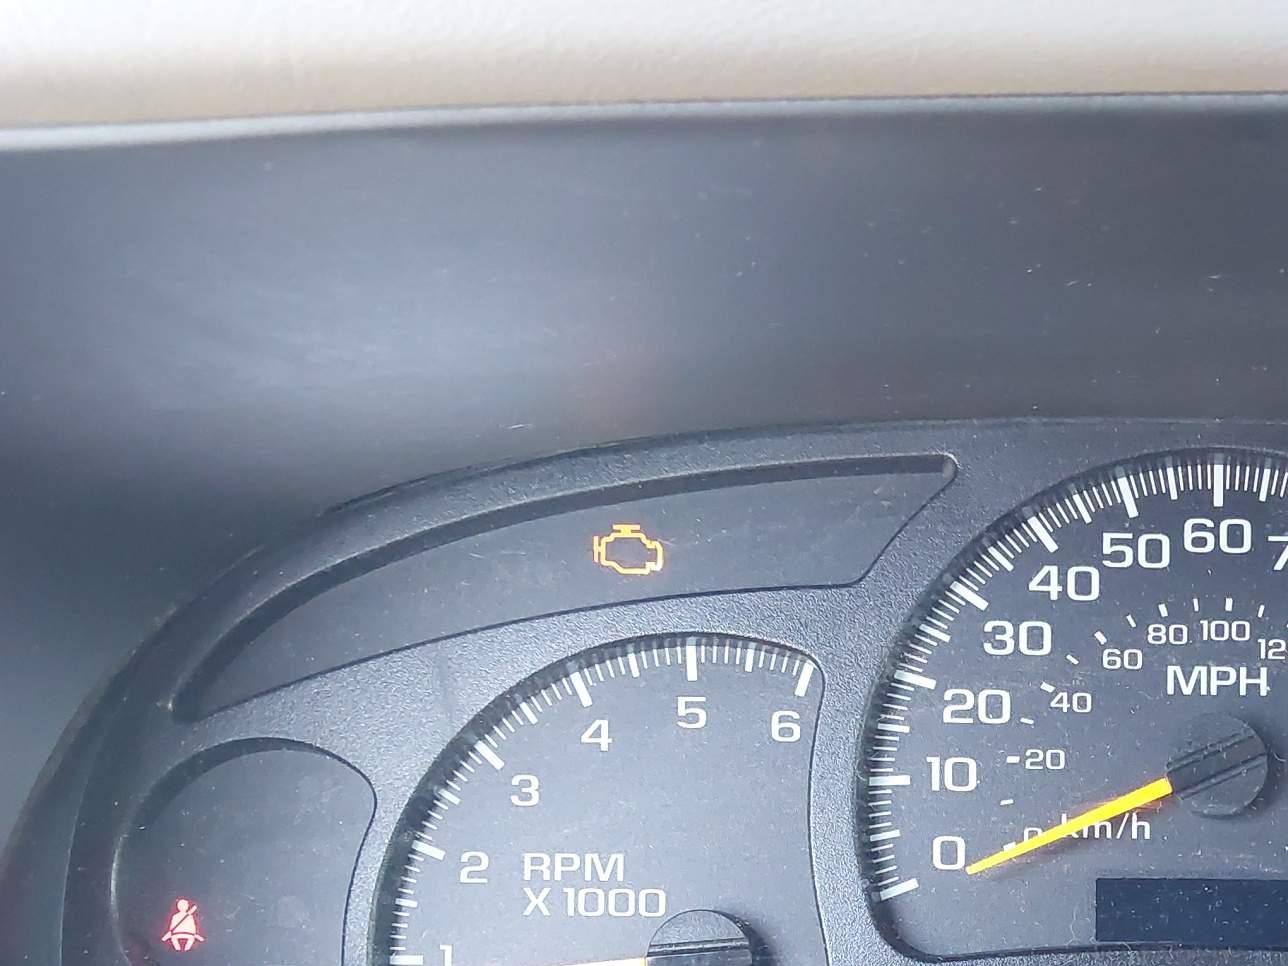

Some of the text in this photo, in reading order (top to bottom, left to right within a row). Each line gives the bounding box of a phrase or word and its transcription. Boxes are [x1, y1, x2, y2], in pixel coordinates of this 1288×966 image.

[1102, 532, 1170, 569] 50
[1183, 518, 1252, 554] 60
[1028, 565, 1100, 601] 40
[983, 620, 1052, 656] 30
[1147, 623, 1187, 645] 80
[1200, 620, 1251, 642] 100
[1102, 648, 1143, 670] 60
[1166, 665, 1268, 697] MPH
[677, 696, 707, 729] 5
[942, 688, 1011, 724] 20
[1050, 691, 1092, 713] 40
[580, 719, 613, 752] 4
[771, 710, 801, 742] 6
[926, 756, 977, 792] 10
[1025, 748, 1066, 770] 20
[510, 774, 540, 807] 3
[459, 851, 489, 883] 2
[523, 852, 624, 882] RPM
[932, 835, 966, 870] 0
[523, 887, 666, 917] X 1000
